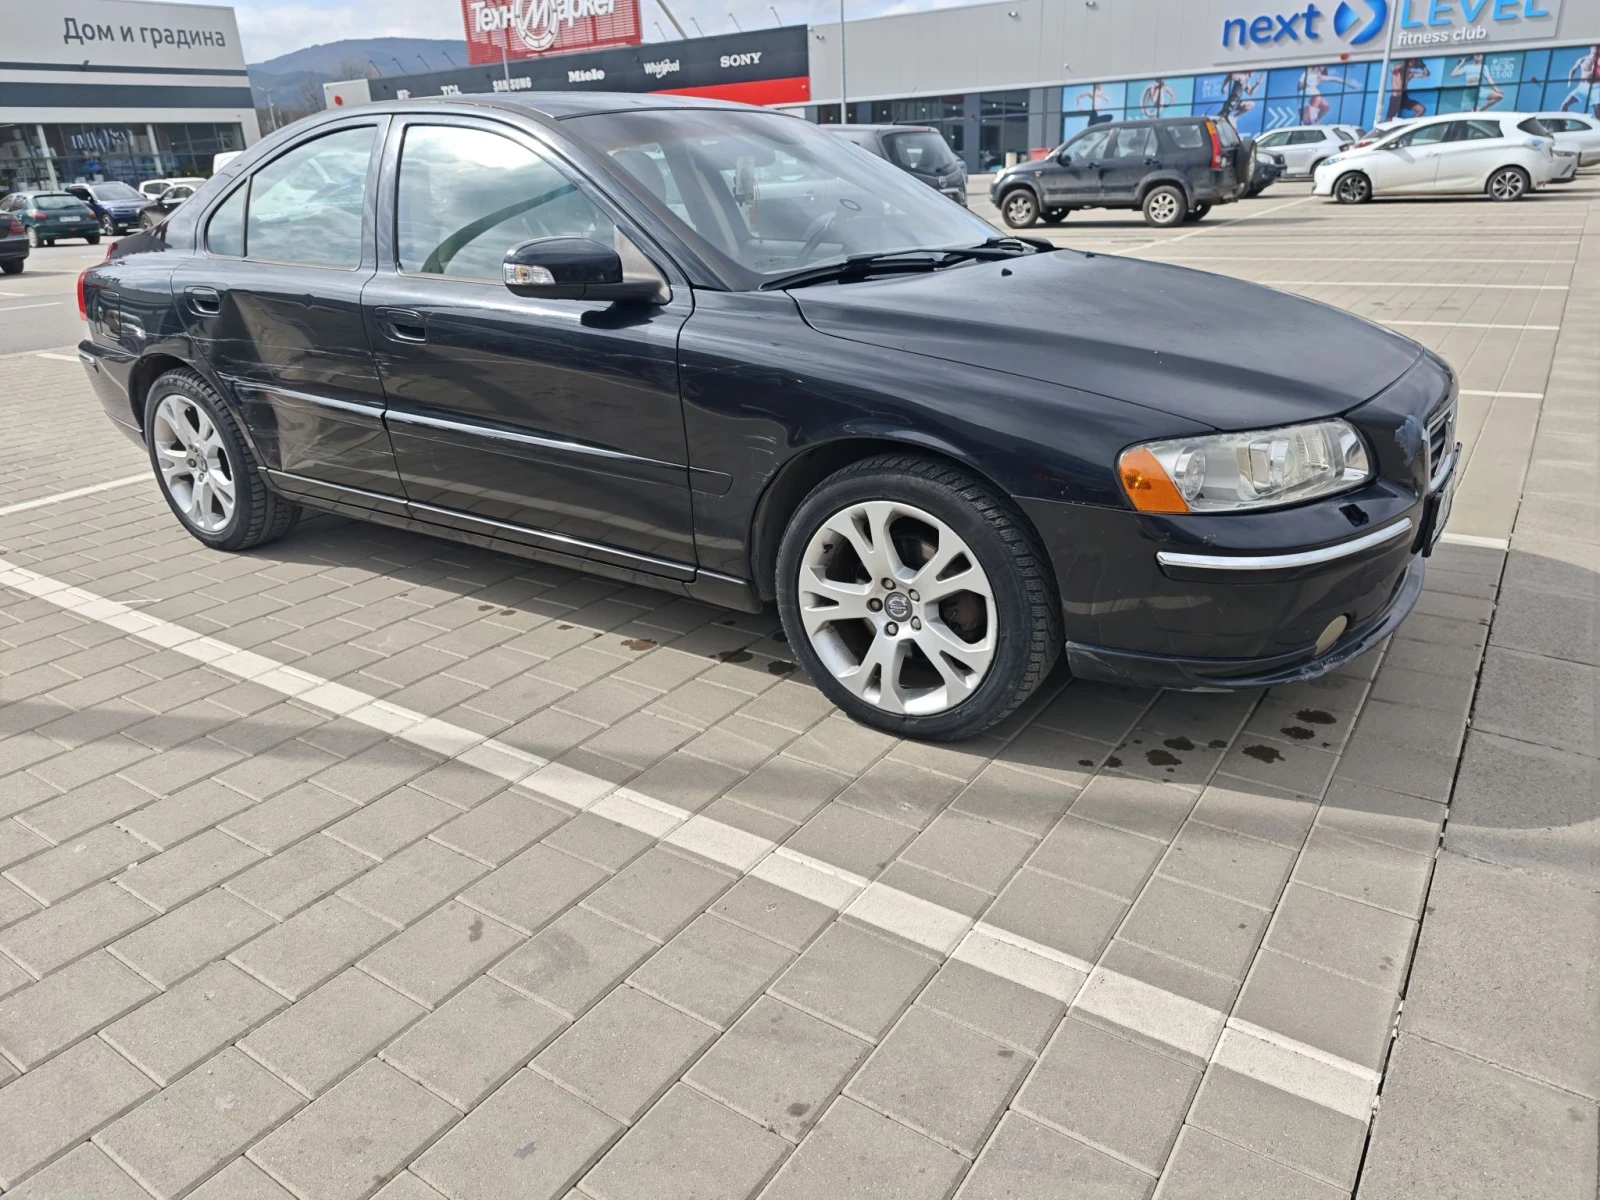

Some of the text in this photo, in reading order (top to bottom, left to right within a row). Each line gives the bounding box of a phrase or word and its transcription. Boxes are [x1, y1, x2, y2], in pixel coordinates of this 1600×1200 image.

[63, 17, 226, 49] Дом и градина
[1223, 3, 1322, 46] next
[1398, 26, 1487, 46] fitness club
[643, 58, 680, 79] Whirlpool
[719, 51, 762, 68] SONY
[567, 68, 606, 83] Miele
[440, 84, 463, 96] TCL
